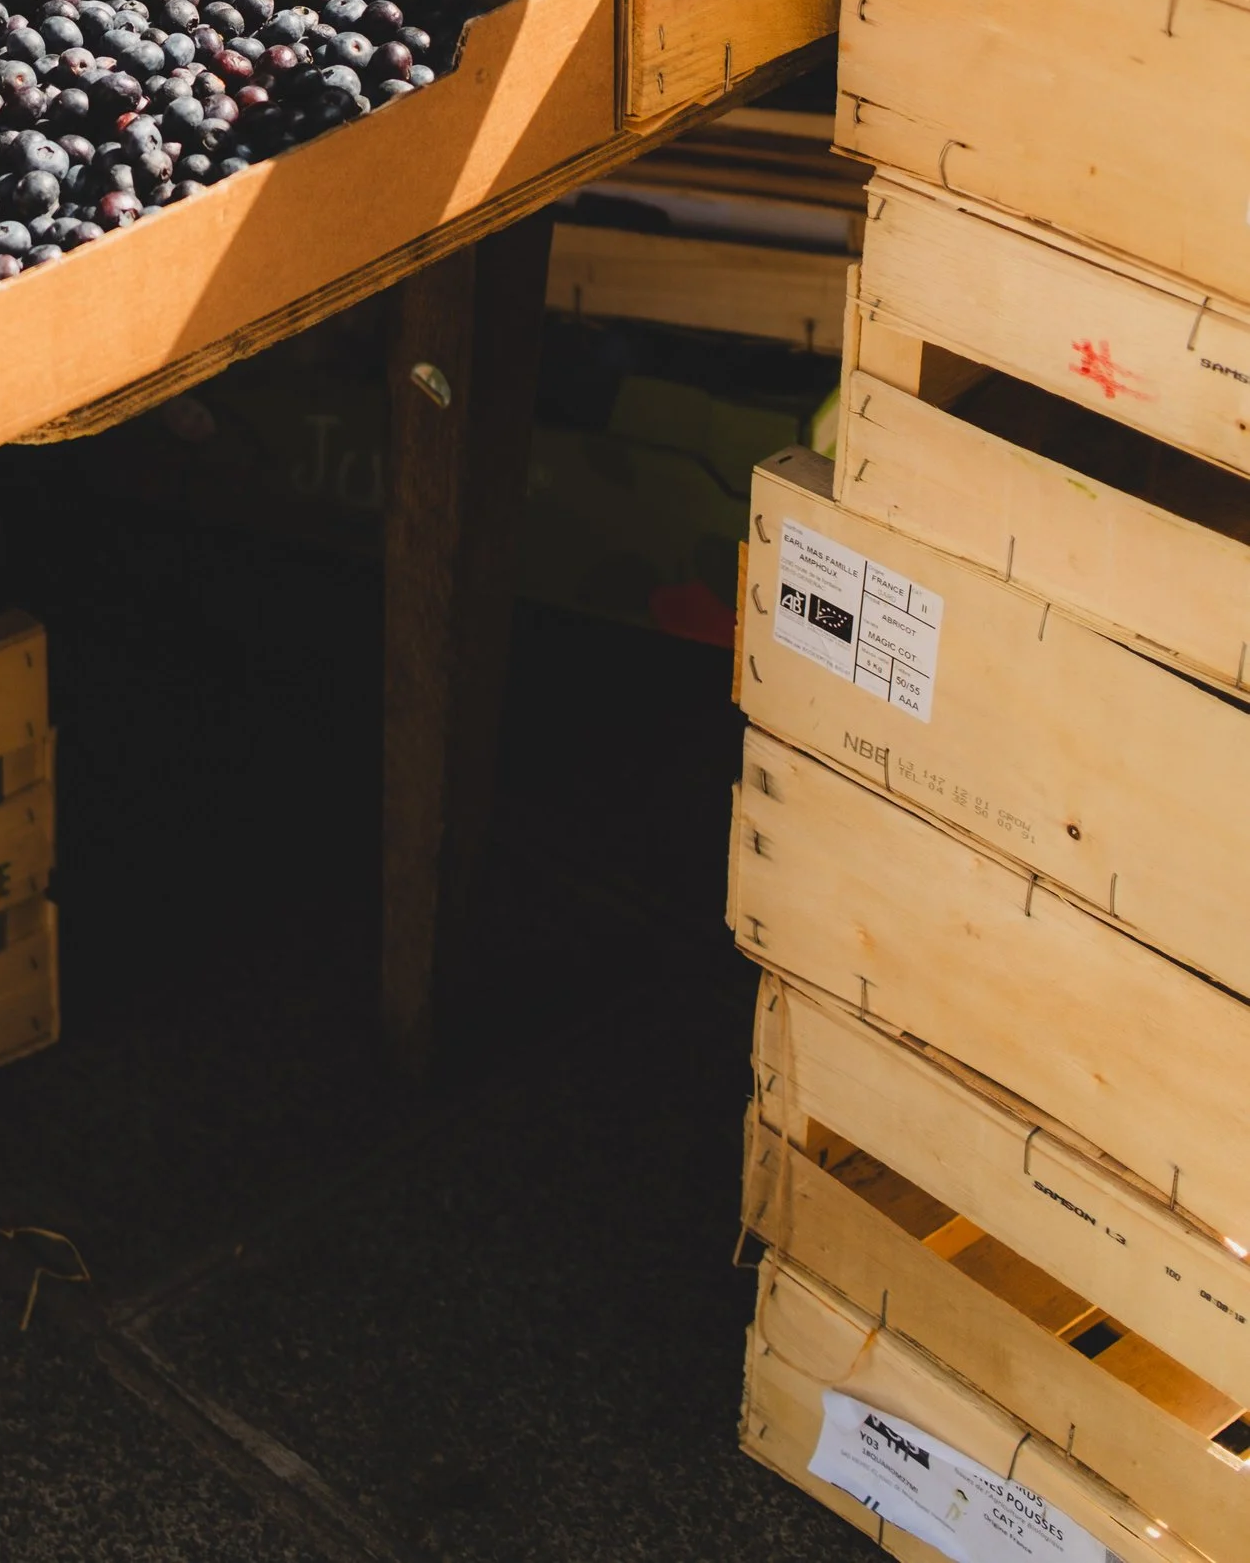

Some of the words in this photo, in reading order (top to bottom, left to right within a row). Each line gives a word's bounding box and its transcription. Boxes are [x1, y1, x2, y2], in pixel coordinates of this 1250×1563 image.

[783, 534, 806, 552] EARL
[806, 544, 825, 561] MAS
[824, 554, 860, 580] FAMILLE
[798, 553, 839, 580] AMPHOUX
[870, 573, 905, 597] FRANCE
[781, 592, 803, 614] AB
[881, 614, 917, 637] ABRICOT
[867, 630, 896, 652] MAGIC
[897, 646, 918, 663] COT
[895, 676, 921, 697] 50/55
[898, 694, 920, 711] AAA
[1032, 1178, 1098, 1227] SAMSON
[1105, 1226, 1128, 1246] L3
[992, 1507, 1016, 1530] CAT
[1016, 1525, 1024, 1537] 2
[1006, 1494, 1065, 1543] POUSSES
